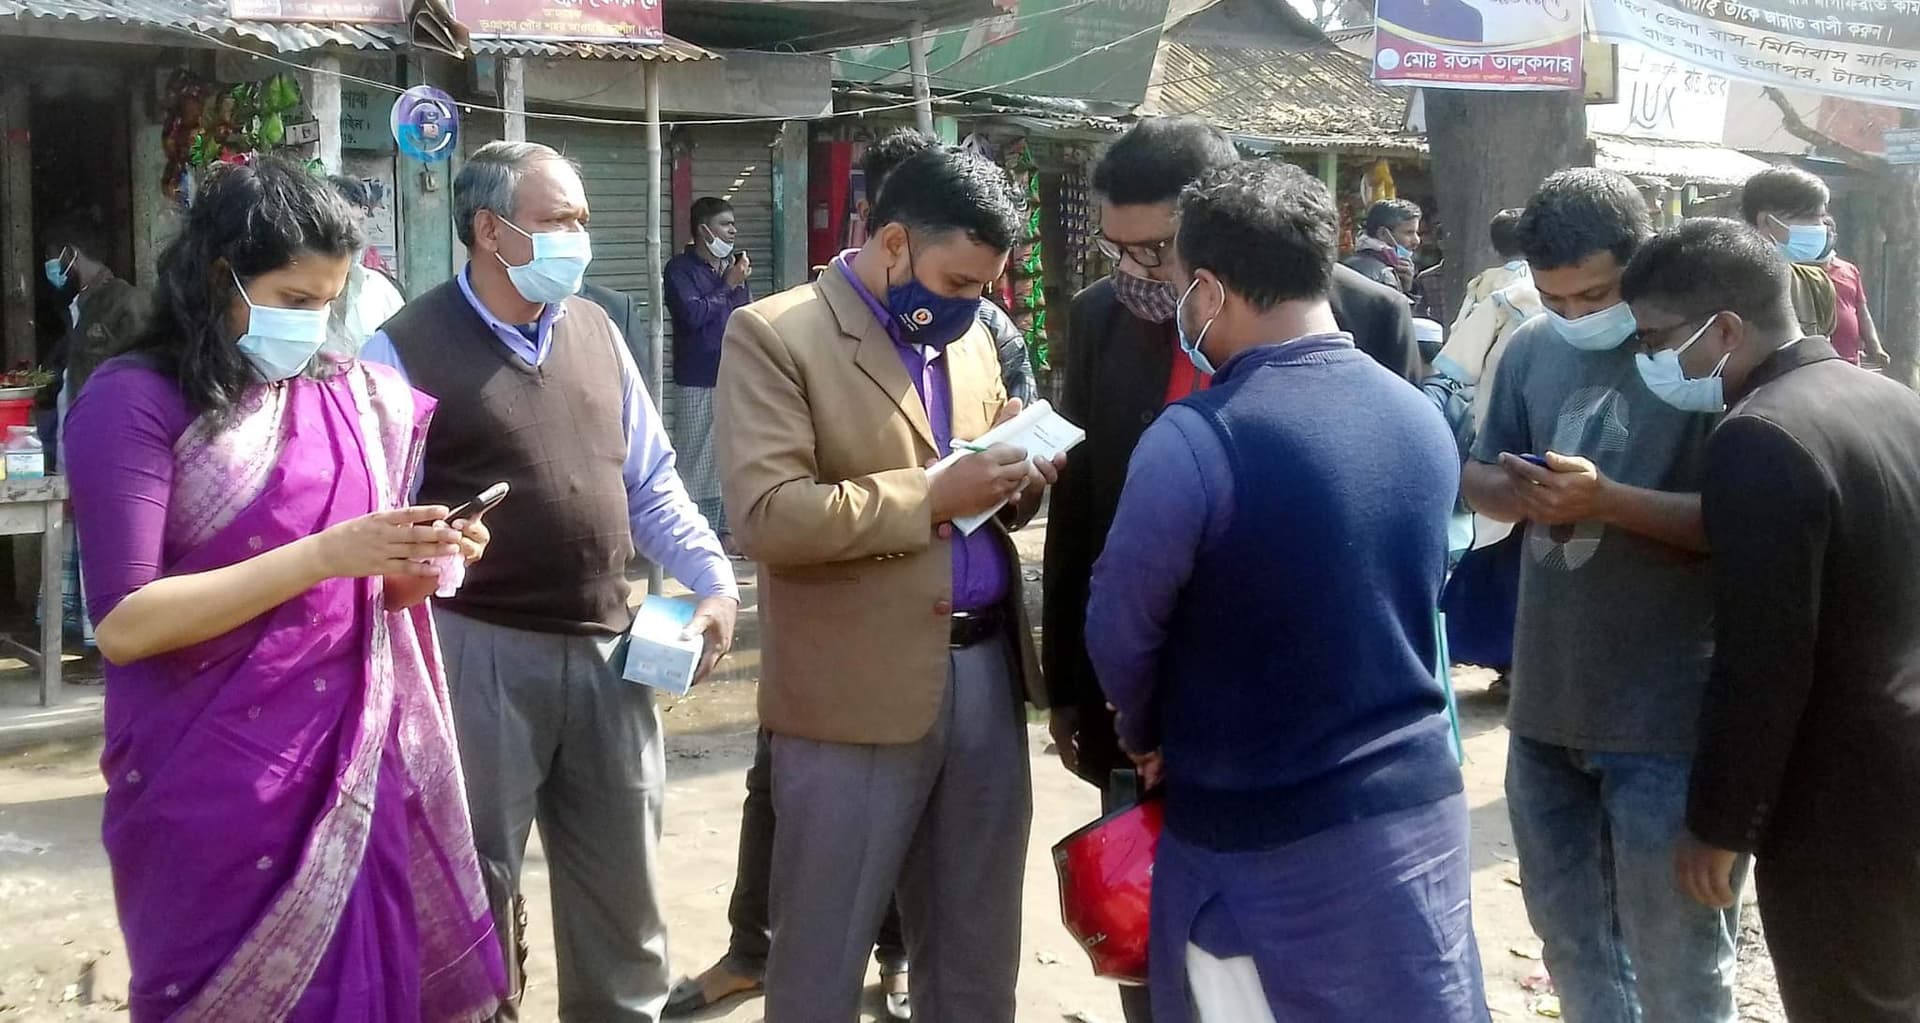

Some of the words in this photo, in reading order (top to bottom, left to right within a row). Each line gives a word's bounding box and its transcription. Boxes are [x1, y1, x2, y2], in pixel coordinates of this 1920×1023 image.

[1655, 12, 1699, 36] জেলা
[1403, 51, 1437, 69] মোঃ
[1442, 53, 1485, 72] রতন
[1490, 53, 1574, 76] তালুকদার
